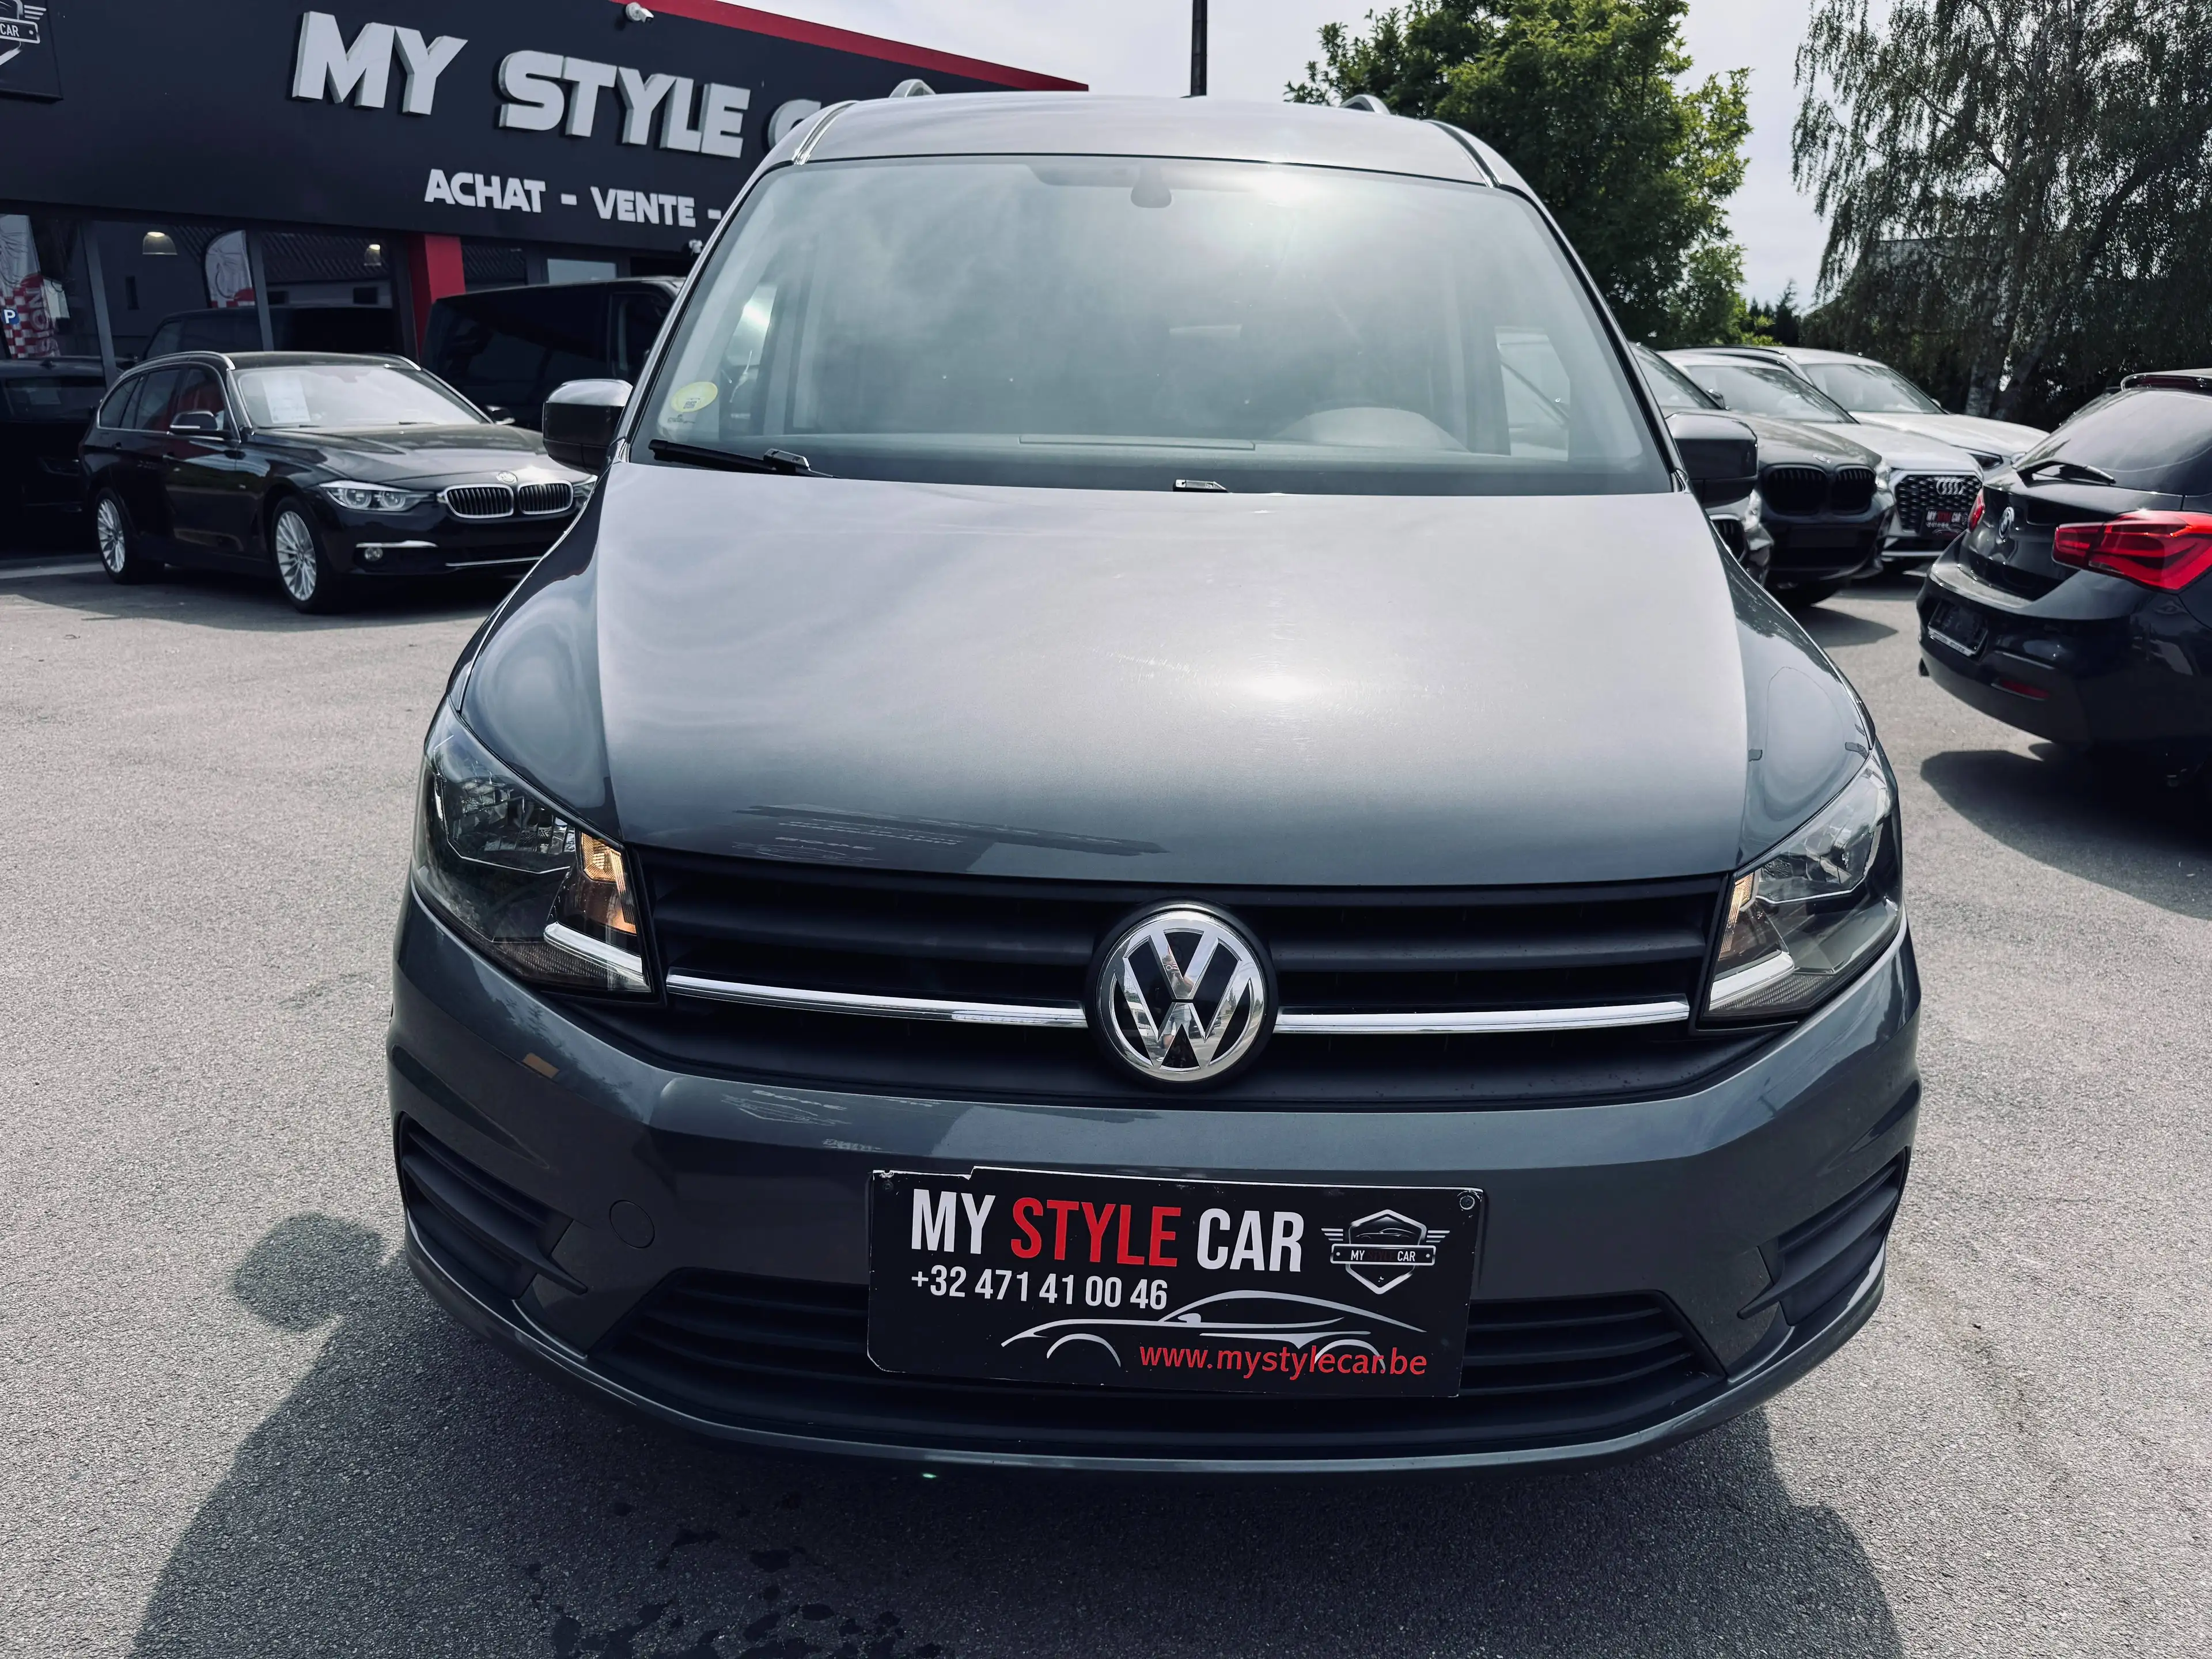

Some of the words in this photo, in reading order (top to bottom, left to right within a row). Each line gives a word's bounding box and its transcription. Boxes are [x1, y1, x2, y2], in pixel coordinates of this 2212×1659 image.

[0, 23, 20, 37] CAR
[292, 11, 468, 115] MY
[499, 50, 751, 158] STYLE
[425, 169, 546, 213] ACHAT
[590, 186, 696, 228] VENTE
[911, 1188, 996, 1254] MY
[1010, 1197, 1181, 1267] STYLE
[1196, 1208, 1305, 1272] CAR
[1350, 1249, 1365, 1261] MY
[1397, 1251, 1416, 1262] CAR
[911, 1264, 967, 1298] +32
[975, 1269, 1028, 1302] 471
[1039, 1274, 1074, 1305] 41
[1085, 1277, 1122, 1306] 00
[1130, 1279, 1168, 1310] 46
[1139, 1344, 1427, 1381] www.mystylecar.be
